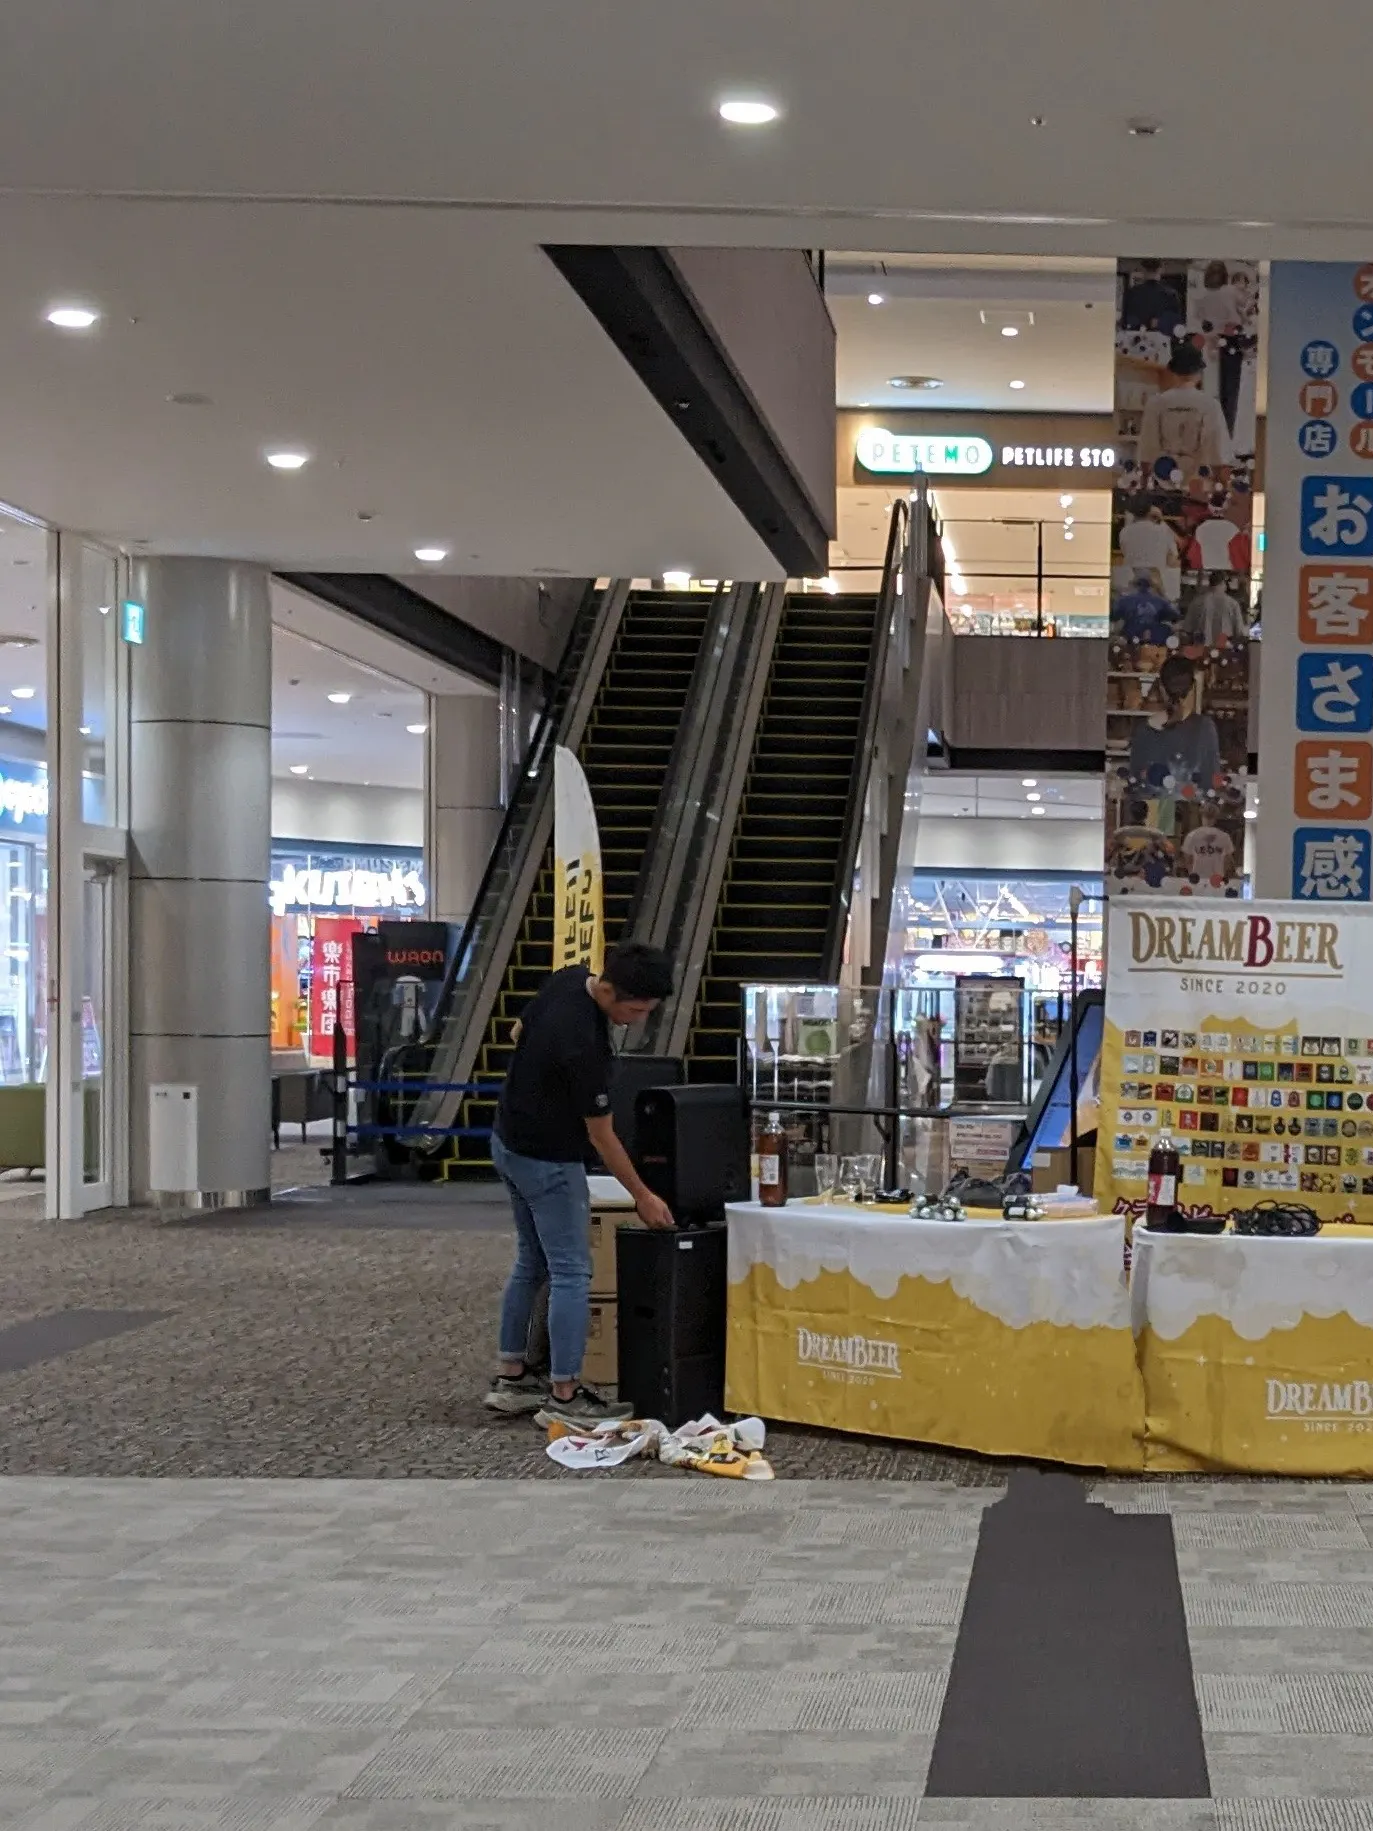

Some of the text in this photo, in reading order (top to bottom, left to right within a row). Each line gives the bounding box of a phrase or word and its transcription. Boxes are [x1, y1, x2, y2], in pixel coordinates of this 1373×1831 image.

[1303, 346, 1336, 453] 専門店
[872, 443, 980, 465] PETEMO
[1002, 446, 1074, 467] PETLIFE
[1128, 911, 1344, 970] DREAMBEER
[1180, 978, 1287, 996] SINCE 2020
